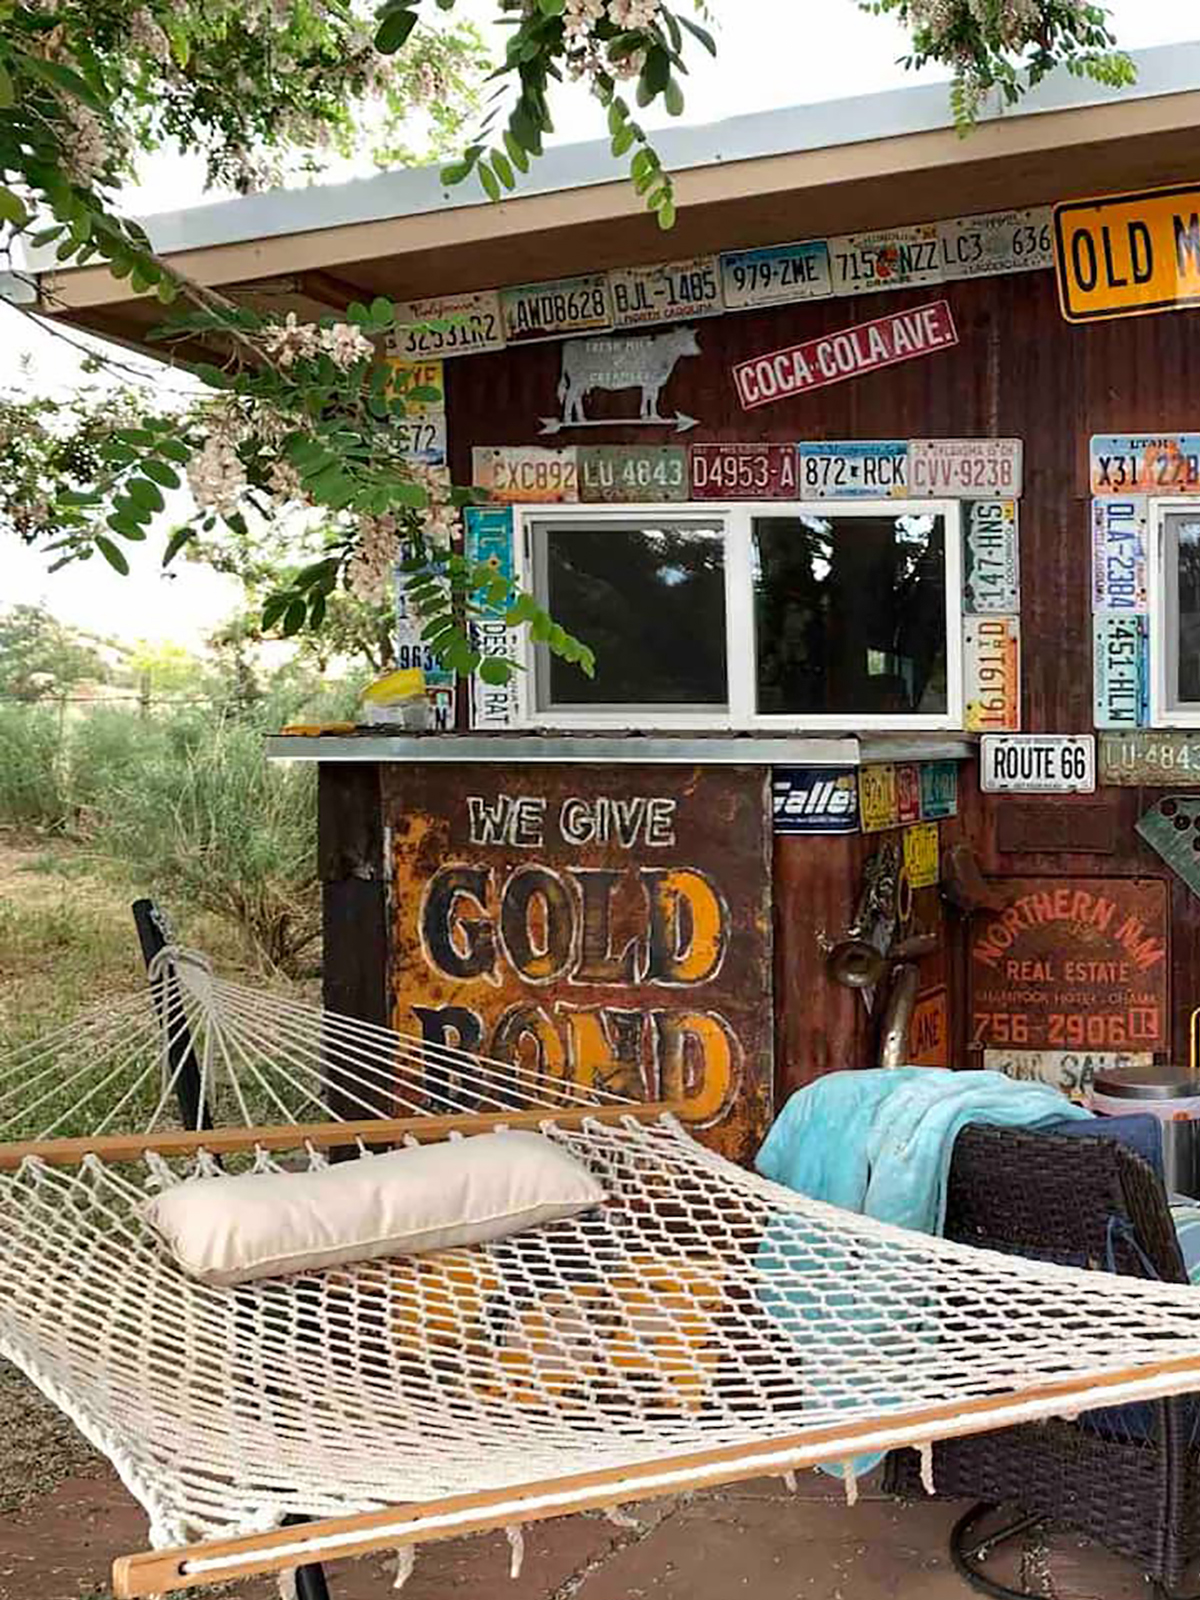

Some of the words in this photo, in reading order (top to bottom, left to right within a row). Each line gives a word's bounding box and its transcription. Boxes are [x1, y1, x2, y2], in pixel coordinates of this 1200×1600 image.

[1012, 224, 1051, 256] 636
[1070, 220, 1153, 294] OLD
[892, 308, 953, 355] AVE.
[806, 456, 847, 486] 872
[863, 456, 906, 486] RCK
[993, 746, 1055, 779] ROUTE
[1061, 746, 1086, 779] 66
[467, 794, 546, 848] WE
[560, 796, 677, 848] GIVE
[418, 862, 732, 988] GOLD
[973, 888, 1117, 968] NORTHERN
[1005, 959, 1055, 982] REAL
[1064, 960, 1131, 983] ESTATE
